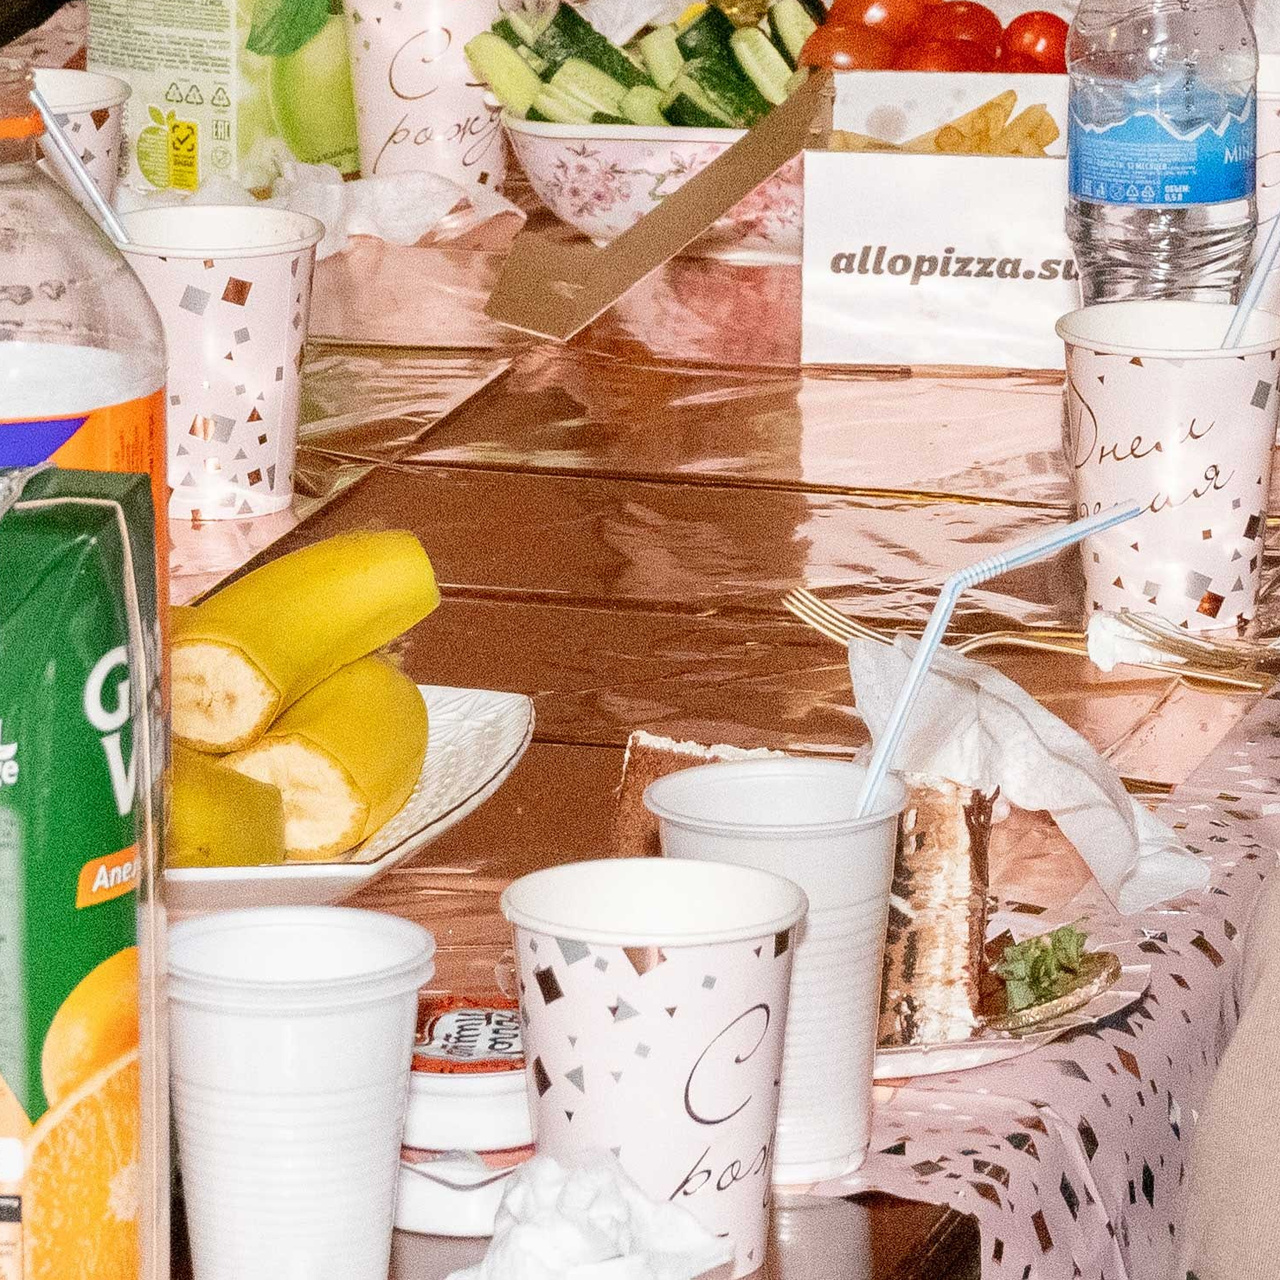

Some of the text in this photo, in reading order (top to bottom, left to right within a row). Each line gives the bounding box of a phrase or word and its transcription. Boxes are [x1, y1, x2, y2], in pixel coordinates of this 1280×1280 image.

[1225, 144, 1254, 164] MIN
[830, 245, 1079, 285] allopizza.su
[684, 1002, 771, 1125] С
